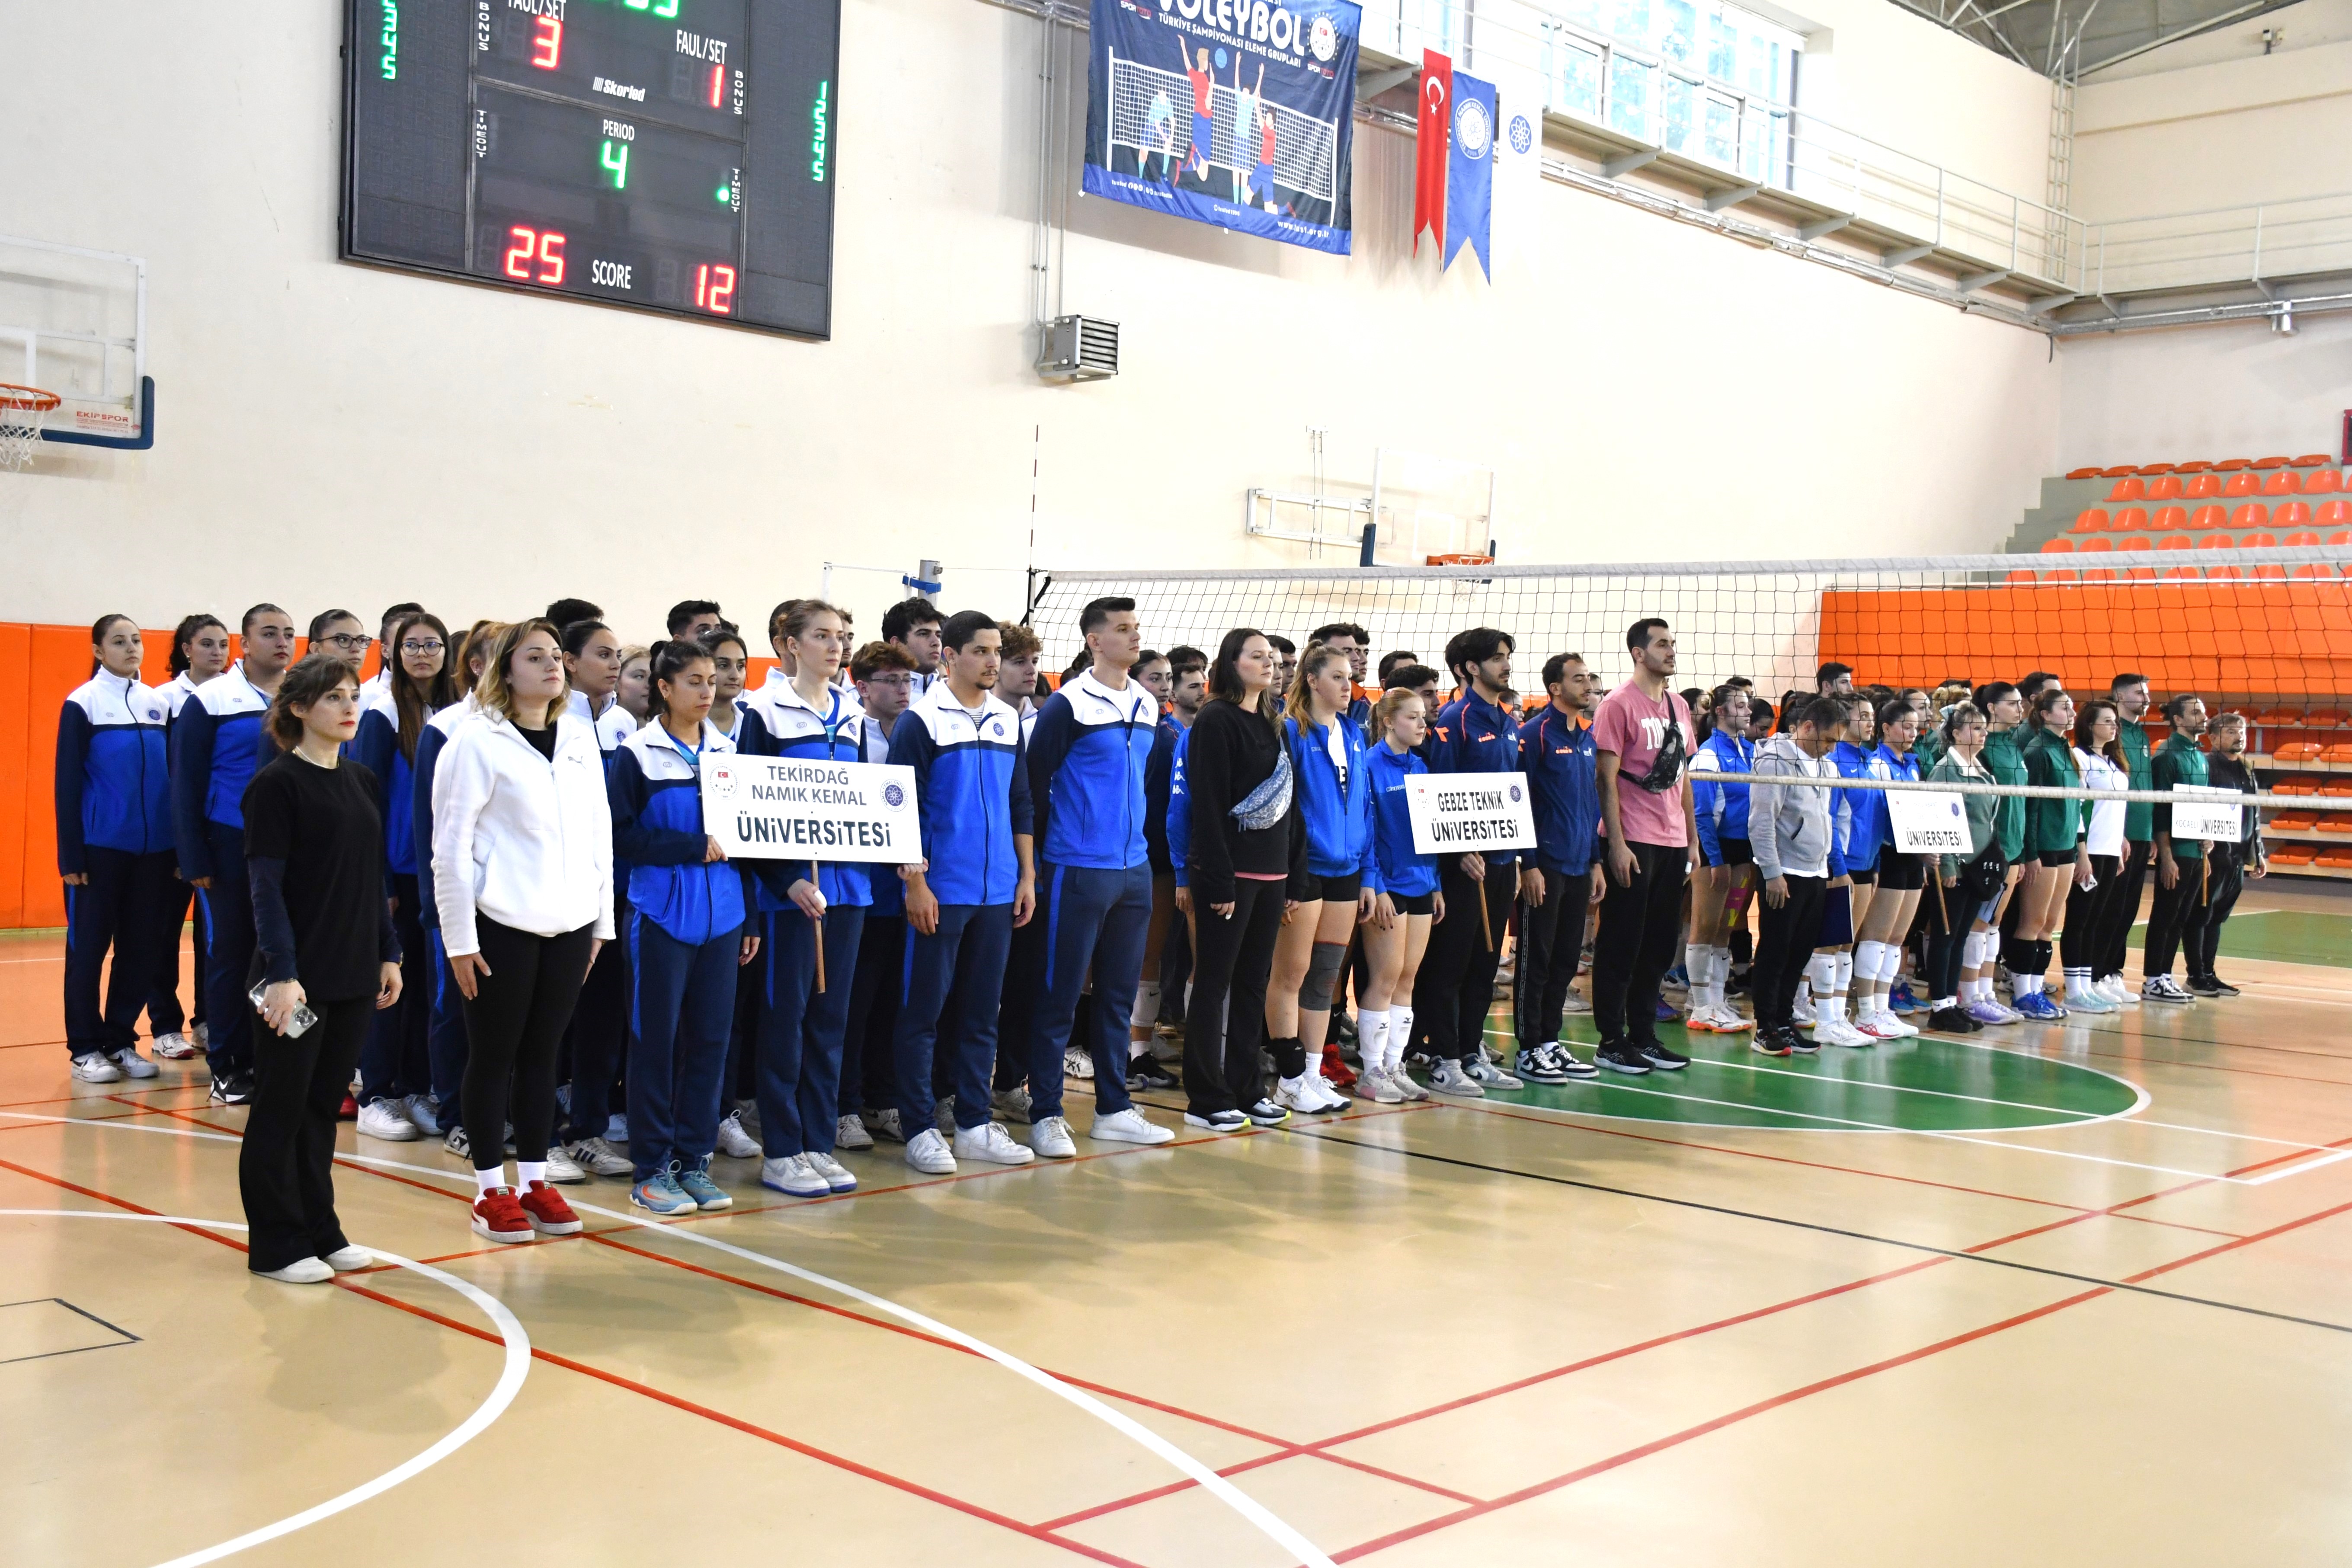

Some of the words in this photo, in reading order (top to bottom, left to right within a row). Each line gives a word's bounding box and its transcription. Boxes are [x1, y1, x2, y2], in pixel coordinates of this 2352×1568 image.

[478, 2, 490, 51] BONUS
[533, 16, 561, 68] 3
[676, 29, 727, 64] FAUL/SET
[1159, 13, 1191, 32] TÜRKİYE
[1192, 24, 1243, 48] ŞAMPİYONASI
[1245, 40, 1267, 56] ELEME
[1267, 48, 1301, 68] GRUPLARI
[603, 79, 646, 102] Skorled
[713, 65, 724, 107] 1
[734, 70, 743, 115] BONUS
[476, 110, 487, 158] TIMEOUT
[603, 119, 635, 141] PERIOD
[602, 141, 627, 189] 4
[731, 168, 741, 212] TIMEOUT
[506, 227, 565, 284] 25
[592, 259, 632, 289] SCORE
[698, 265, 735, 313] 12
[752, 784, 807, 802] NAMIK
[813, 788, 867, 806] KEMAL
[767, 764, 849, 785] TEKİRDAĞ
[1438, 792, 1469, 812] GEBZE
